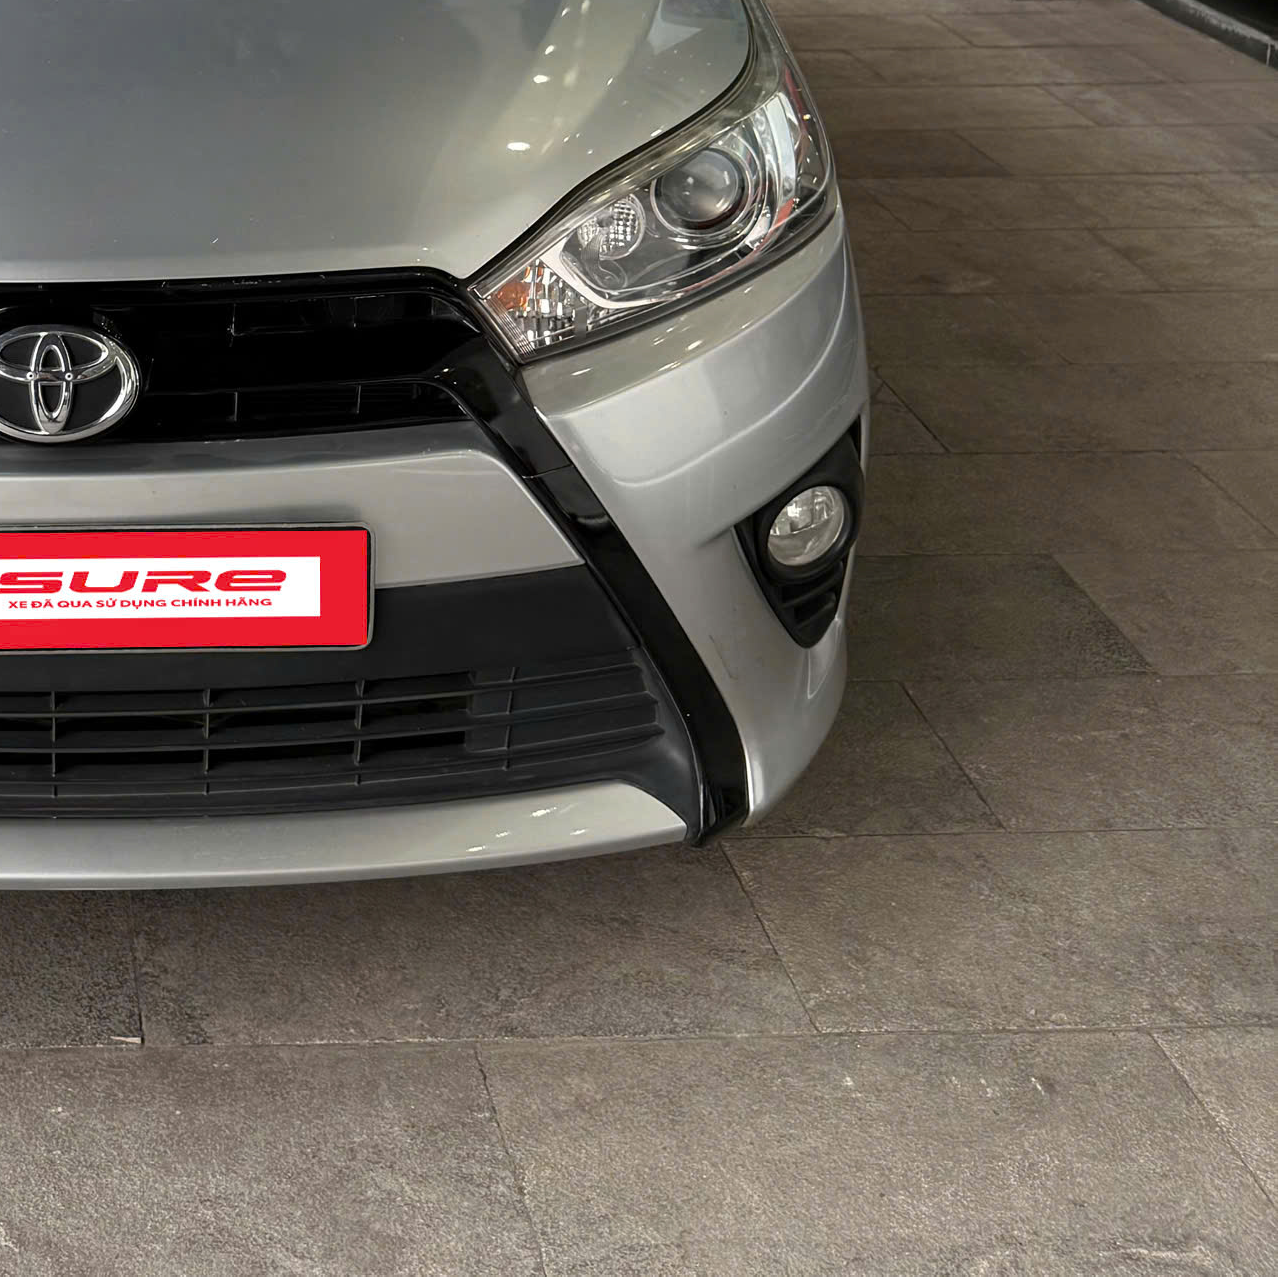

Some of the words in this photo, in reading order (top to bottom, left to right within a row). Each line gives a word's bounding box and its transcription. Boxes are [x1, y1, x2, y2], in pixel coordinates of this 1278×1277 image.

[9, 601, 28, 609] XE
[30, 598, 55, 609] ĐÃ
[57, 600, 93, 609] QUA
[96, 597, 117, 608] SỬ
[120, 600, 167, 610] DỤNG
[171, 597, 222, 607] CHÍNH
[225, 597, 272, 607] HÃNG
